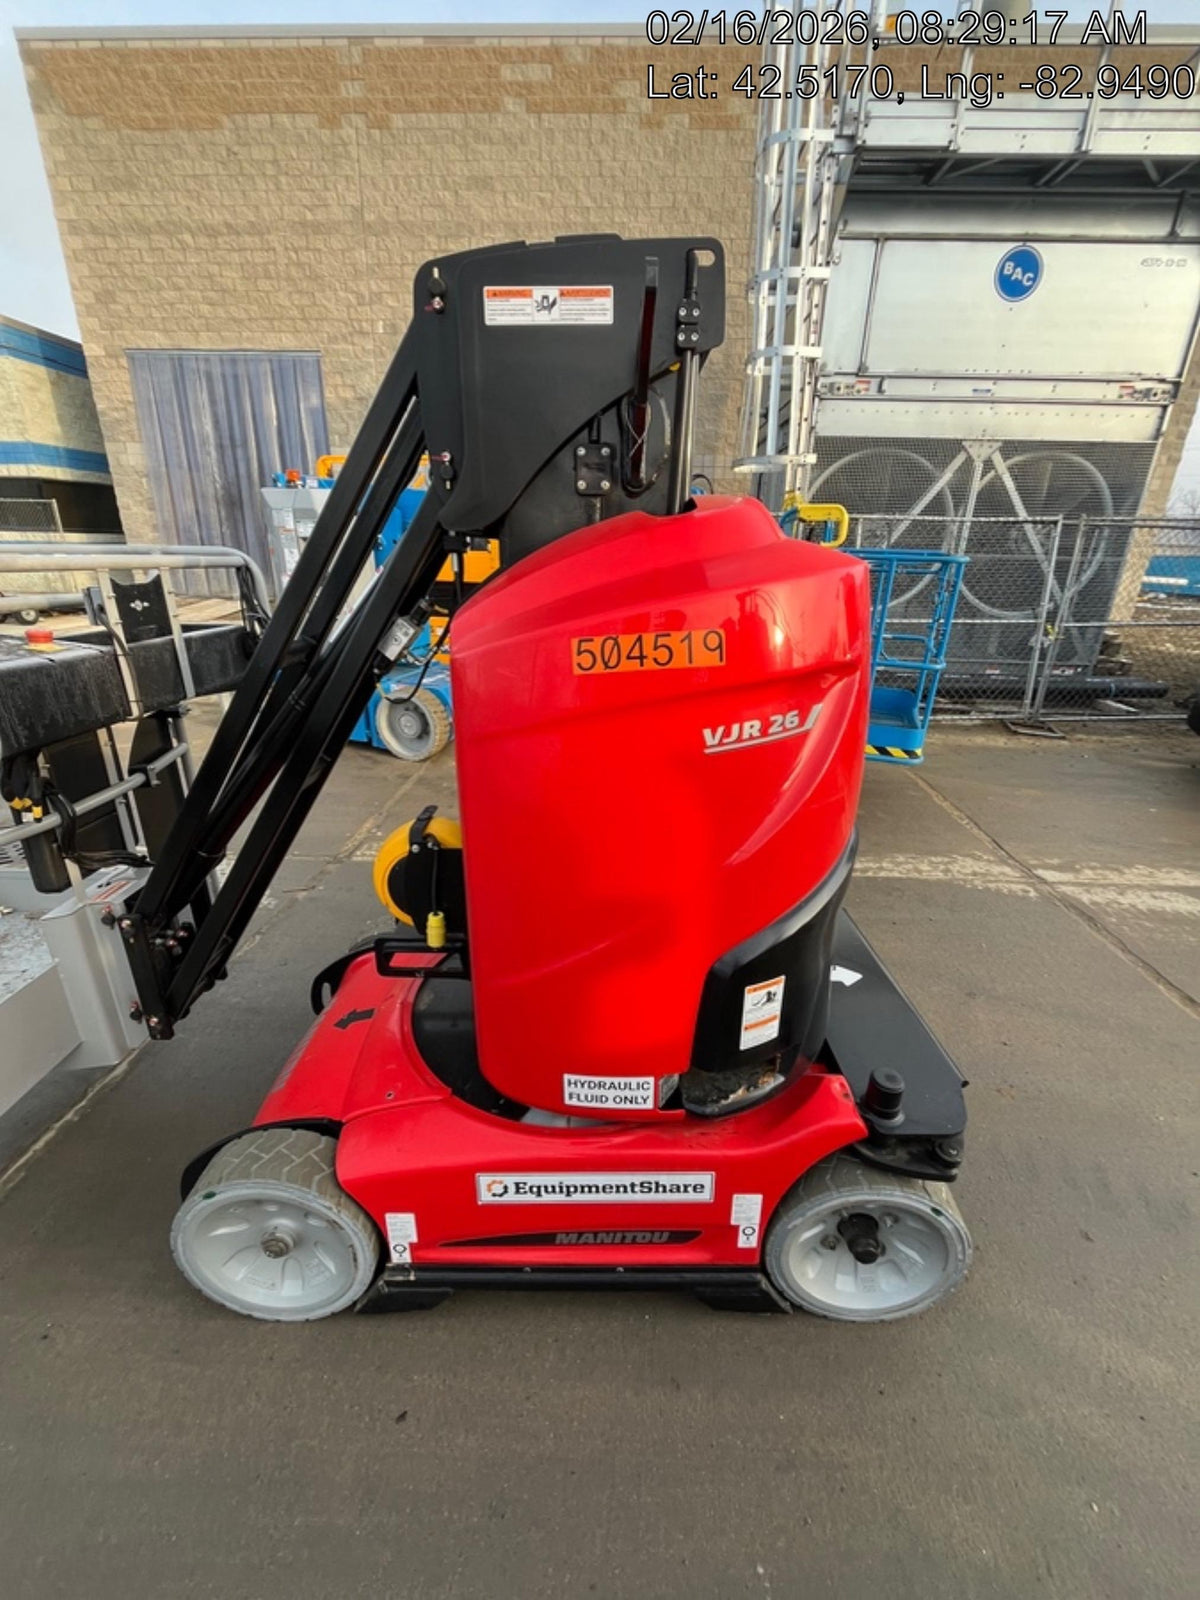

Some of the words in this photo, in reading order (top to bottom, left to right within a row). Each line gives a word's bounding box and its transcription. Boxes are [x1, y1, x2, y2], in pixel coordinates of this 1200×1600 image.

[1003, 261, 1034, 286] BAC
[576, 629, 724, 671] 504519
[703, 719, 761, 746] VJR
[768, 710, 799, 734] 26
[567, 1078, 651, 1091] HYDRAULIC
[568, 1093, 609, 1104] FLUID
[613, 1094, 651, 1105] ONLY
[514, 1180, 705, 1197] EquipmentShare
[555, 1231, 671, 1245] MANITOU
